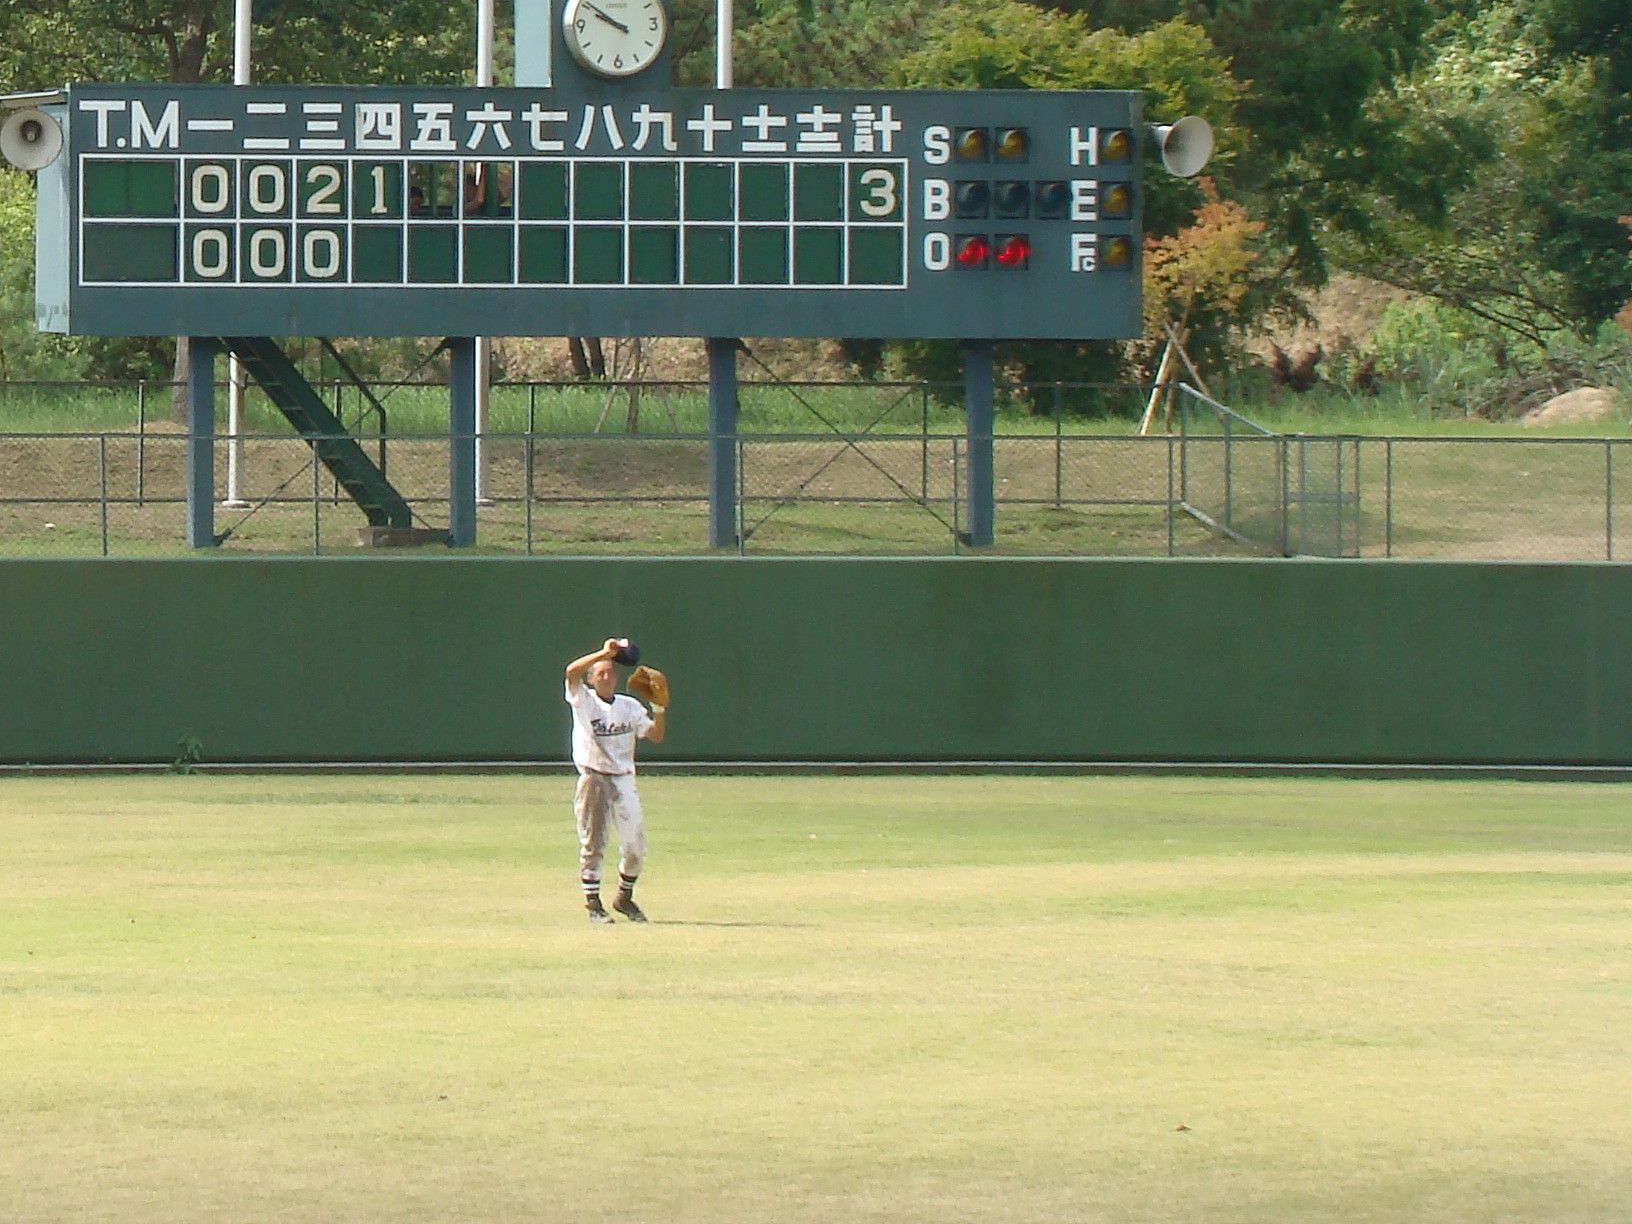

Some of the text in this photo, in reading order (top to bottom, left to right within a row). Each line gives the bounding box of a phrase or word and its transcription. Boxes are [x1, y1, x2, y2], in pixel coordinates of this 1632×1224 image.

[576, 19, 586, 33] 9
[649, 17, 658, 31] 3
[613, 55, 623, 68] 6
[924, 125, 951, 165] S
[1070, 126, 1098, 166] H
[860, 169, 896, 216] 3
[924, 179, 950, 220] B
[1071, 180, 1097, 221] E
